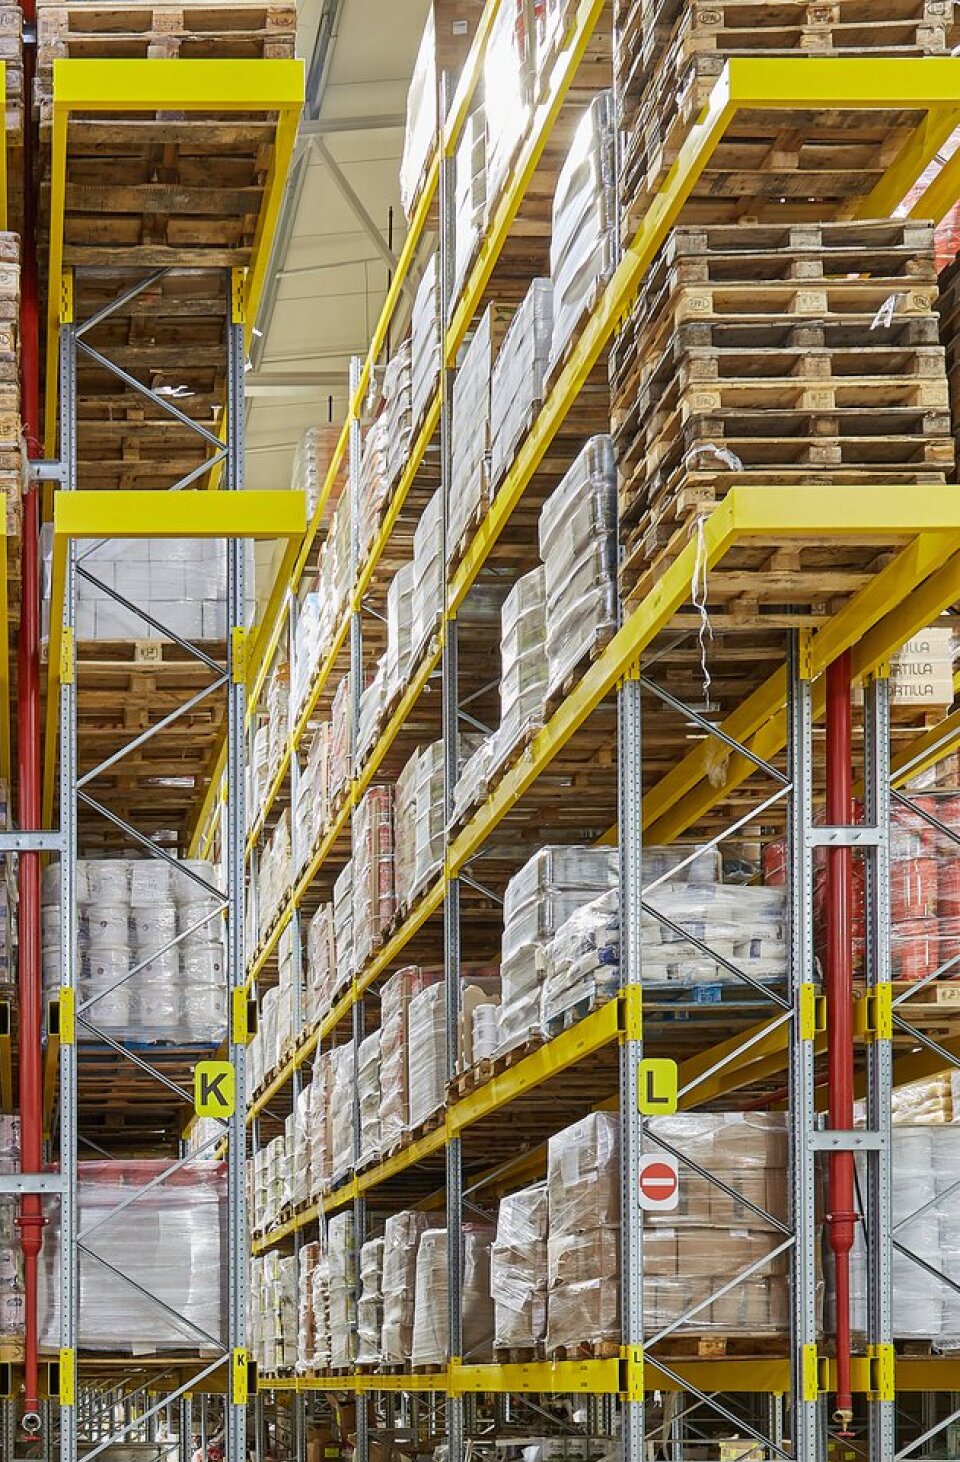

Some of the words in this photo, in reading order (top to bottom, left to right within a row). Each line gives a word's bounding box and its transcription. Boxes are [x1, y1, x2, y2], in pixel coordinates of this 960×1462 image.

[201, 1073, 228, 1105] K
[648, 1072, 668, 1102] L
[237, 1355, 244, 1366] K
[634, 1352, 640, 1362] L
